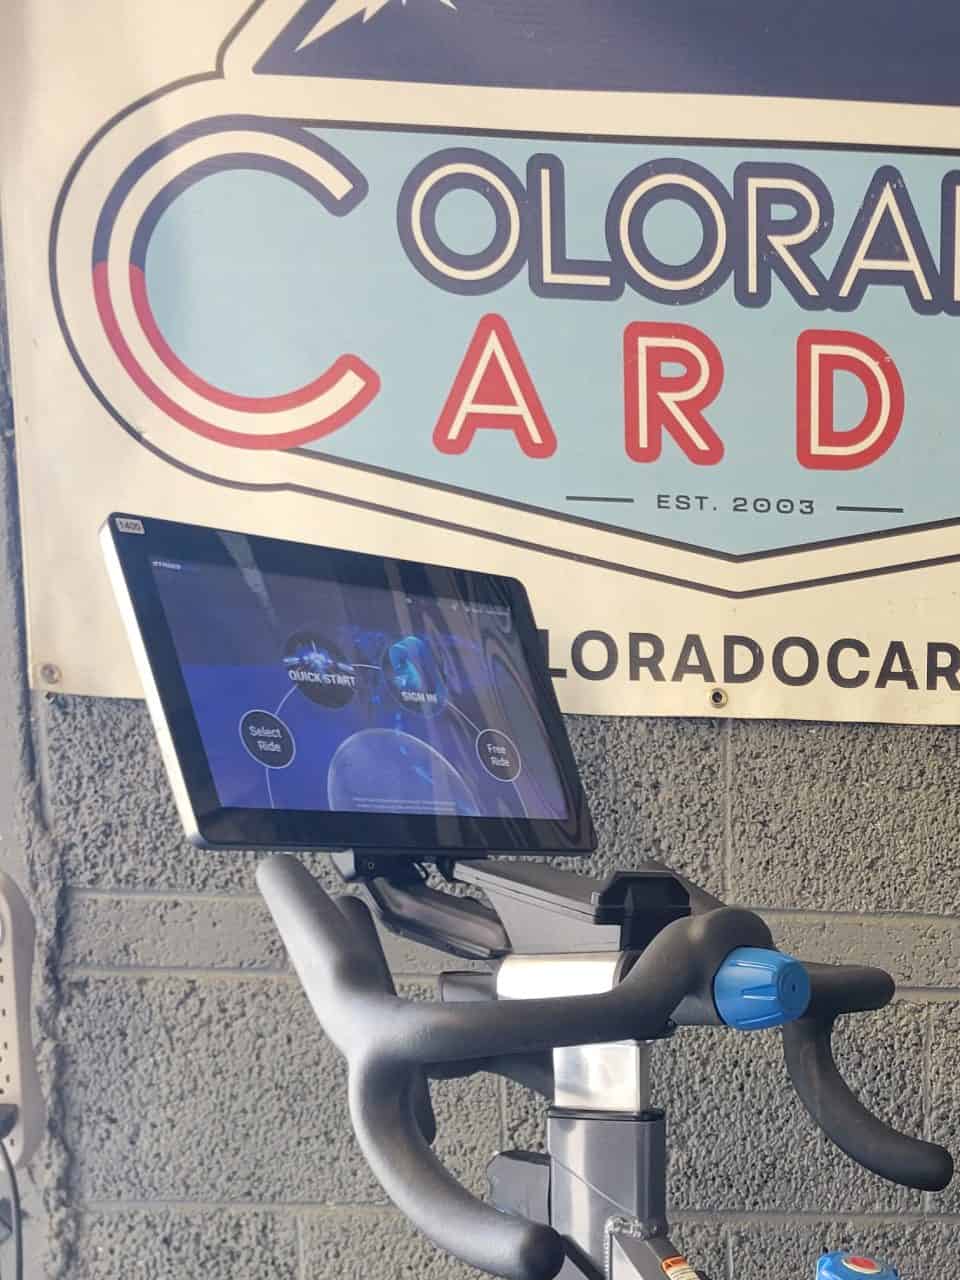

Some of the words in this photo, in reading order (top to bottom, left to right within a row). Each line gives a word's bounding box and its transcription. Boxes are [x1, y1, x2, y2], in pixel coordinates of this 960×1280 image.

[656, 494, 718, 511] EST.
[731, 497, 816, 515] 2003
[288, 669, 321, 684] QUICK
[323, 674, 356, 687] START
[249, 725, 282, 739] Select
[257, 740, 281, 753] Ride
[486, 743, 506, 754] Free
[490, 756, 512, 768] Ride
